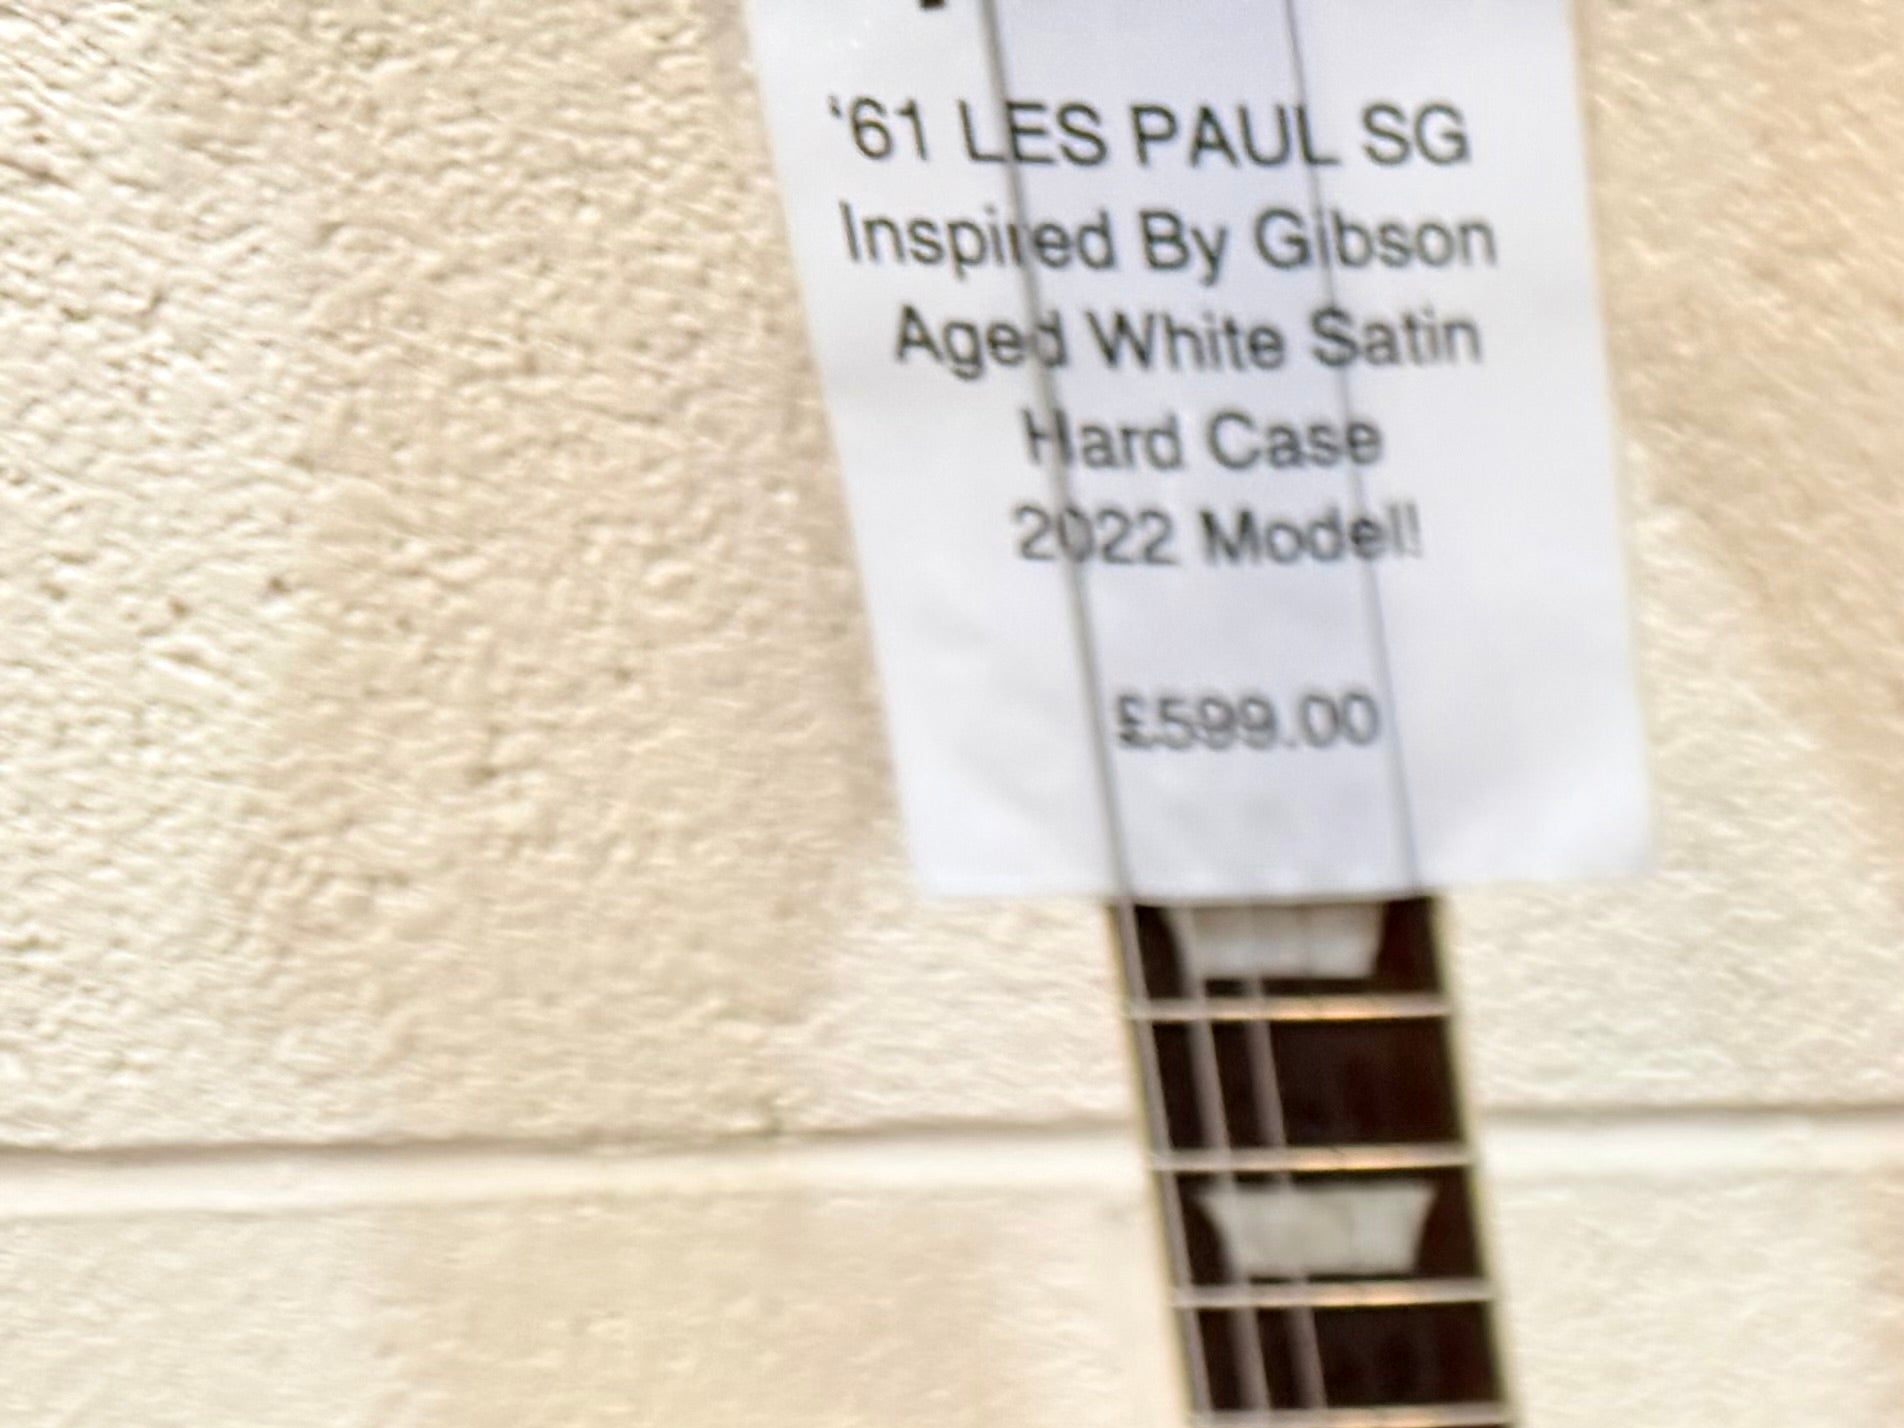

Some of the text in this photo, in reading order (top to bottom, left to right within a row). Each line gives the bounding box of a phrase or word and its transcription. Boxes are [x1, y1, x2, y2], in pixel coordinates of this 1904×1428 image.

[959, 101, 1108, 166] LES
[1132, 102, 1339, 168] PAUL
[1362, 103, 1472, 166] SG
[839, 202, 1497, 284] Inspired By Gibson
[894, 303, 1483, 381] Aged White Satin
[1023, 410, 1384, 473] Hard Case
[1012, 501, 1423, 567] 2022 Model!
[1114, 691, 1379, 750] £599.00
